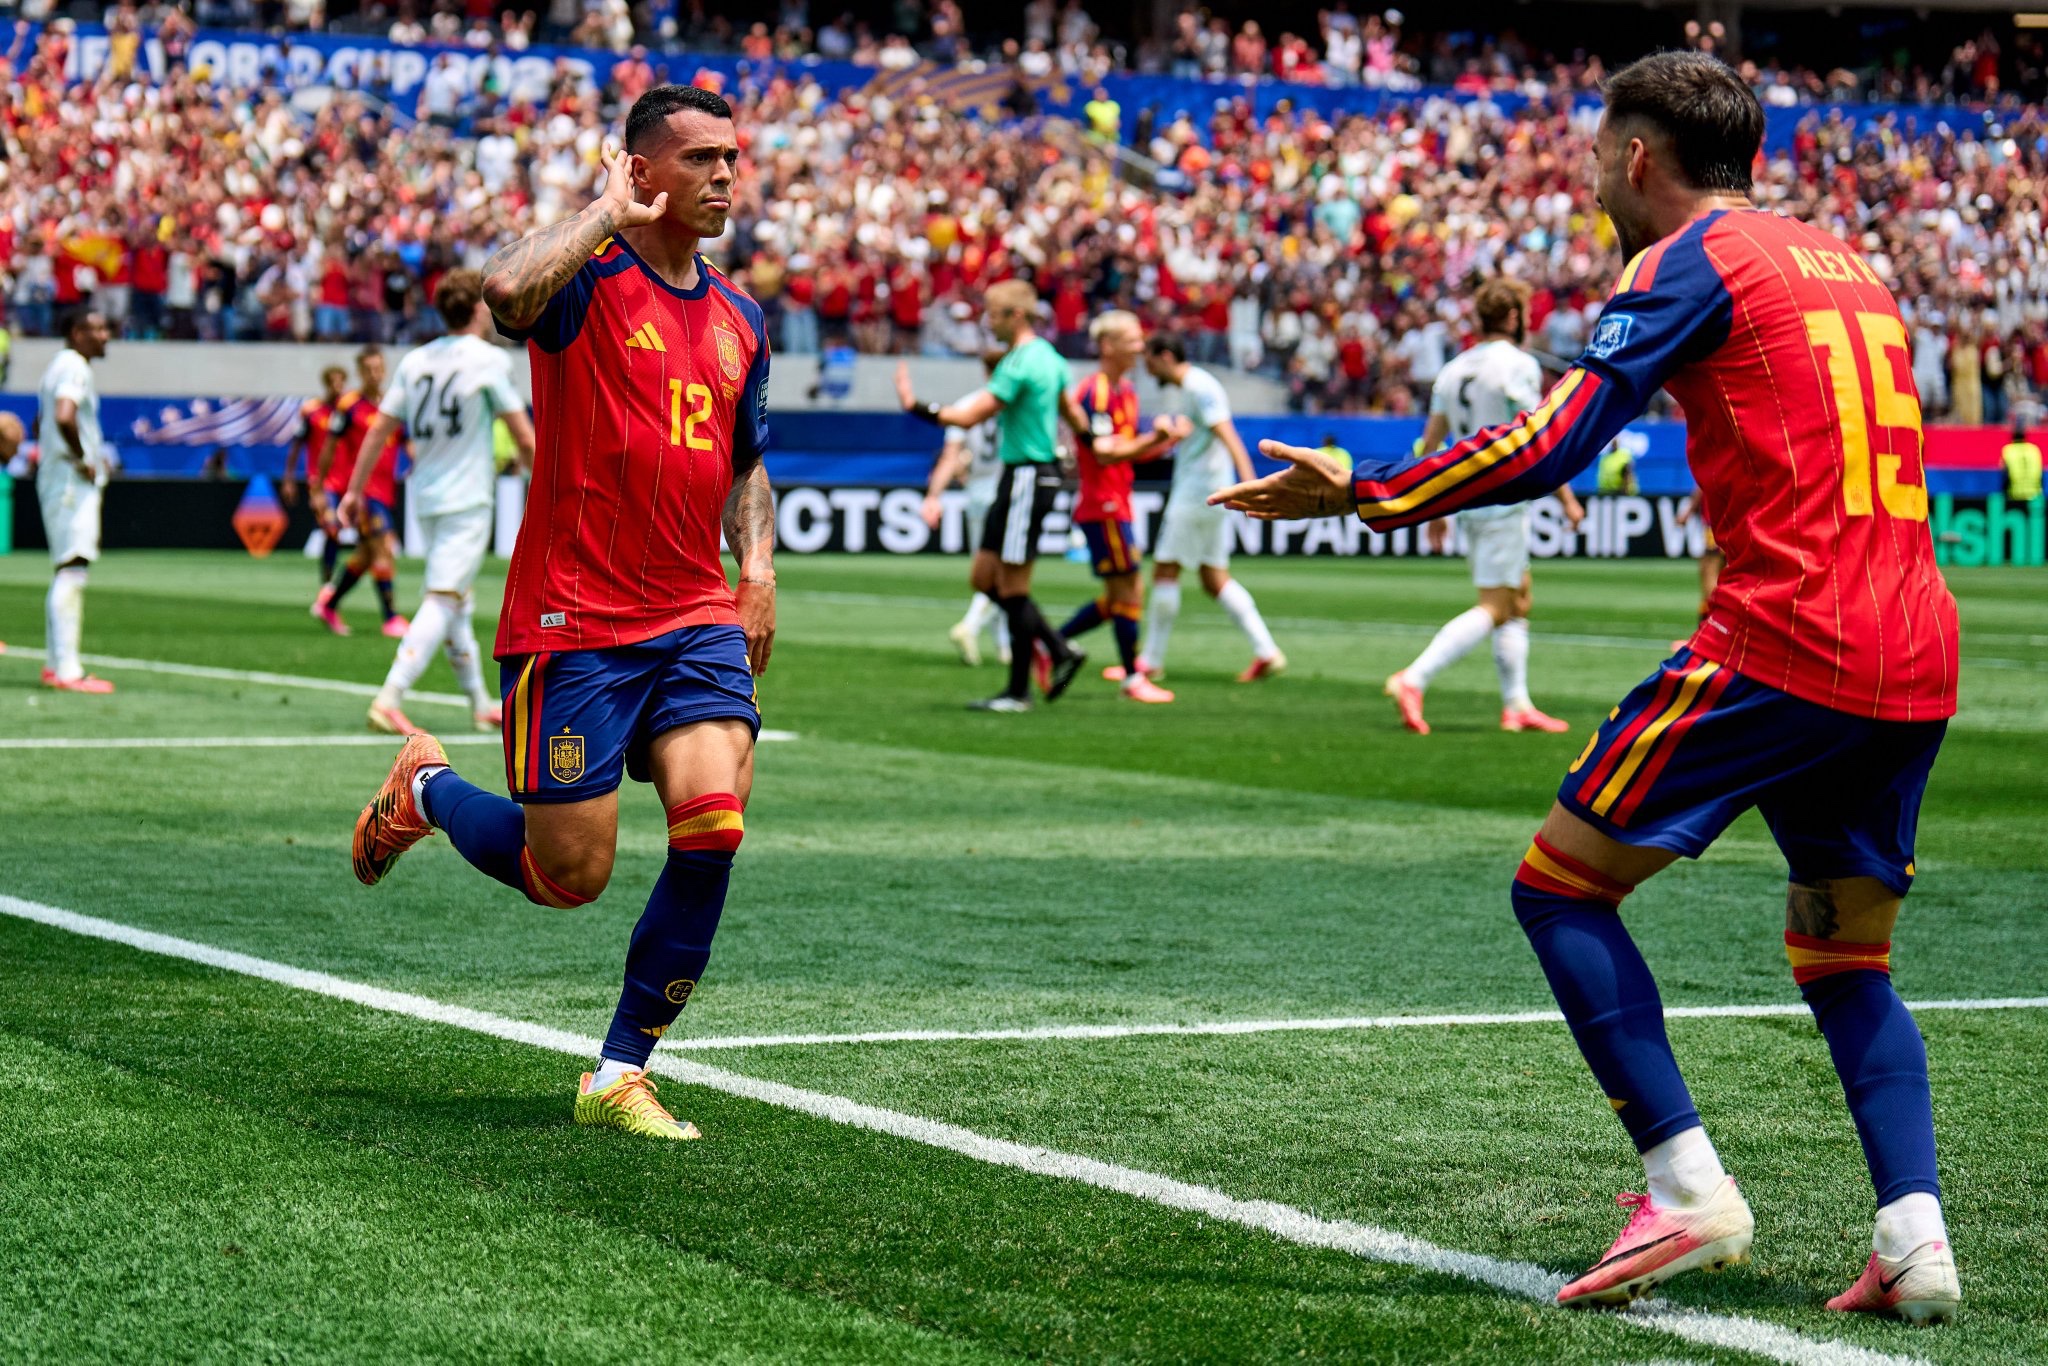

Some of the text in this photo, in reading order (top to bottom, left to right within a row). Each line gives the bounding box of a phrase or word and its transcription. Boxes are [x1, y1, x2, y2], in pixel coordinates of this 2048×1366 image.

[1787, 245, 1863, 283] ALEX
[414, 371, 462, 438] 24
[668, 378, 713, 451] 12
[1803, 309, 1929, 522] 15
